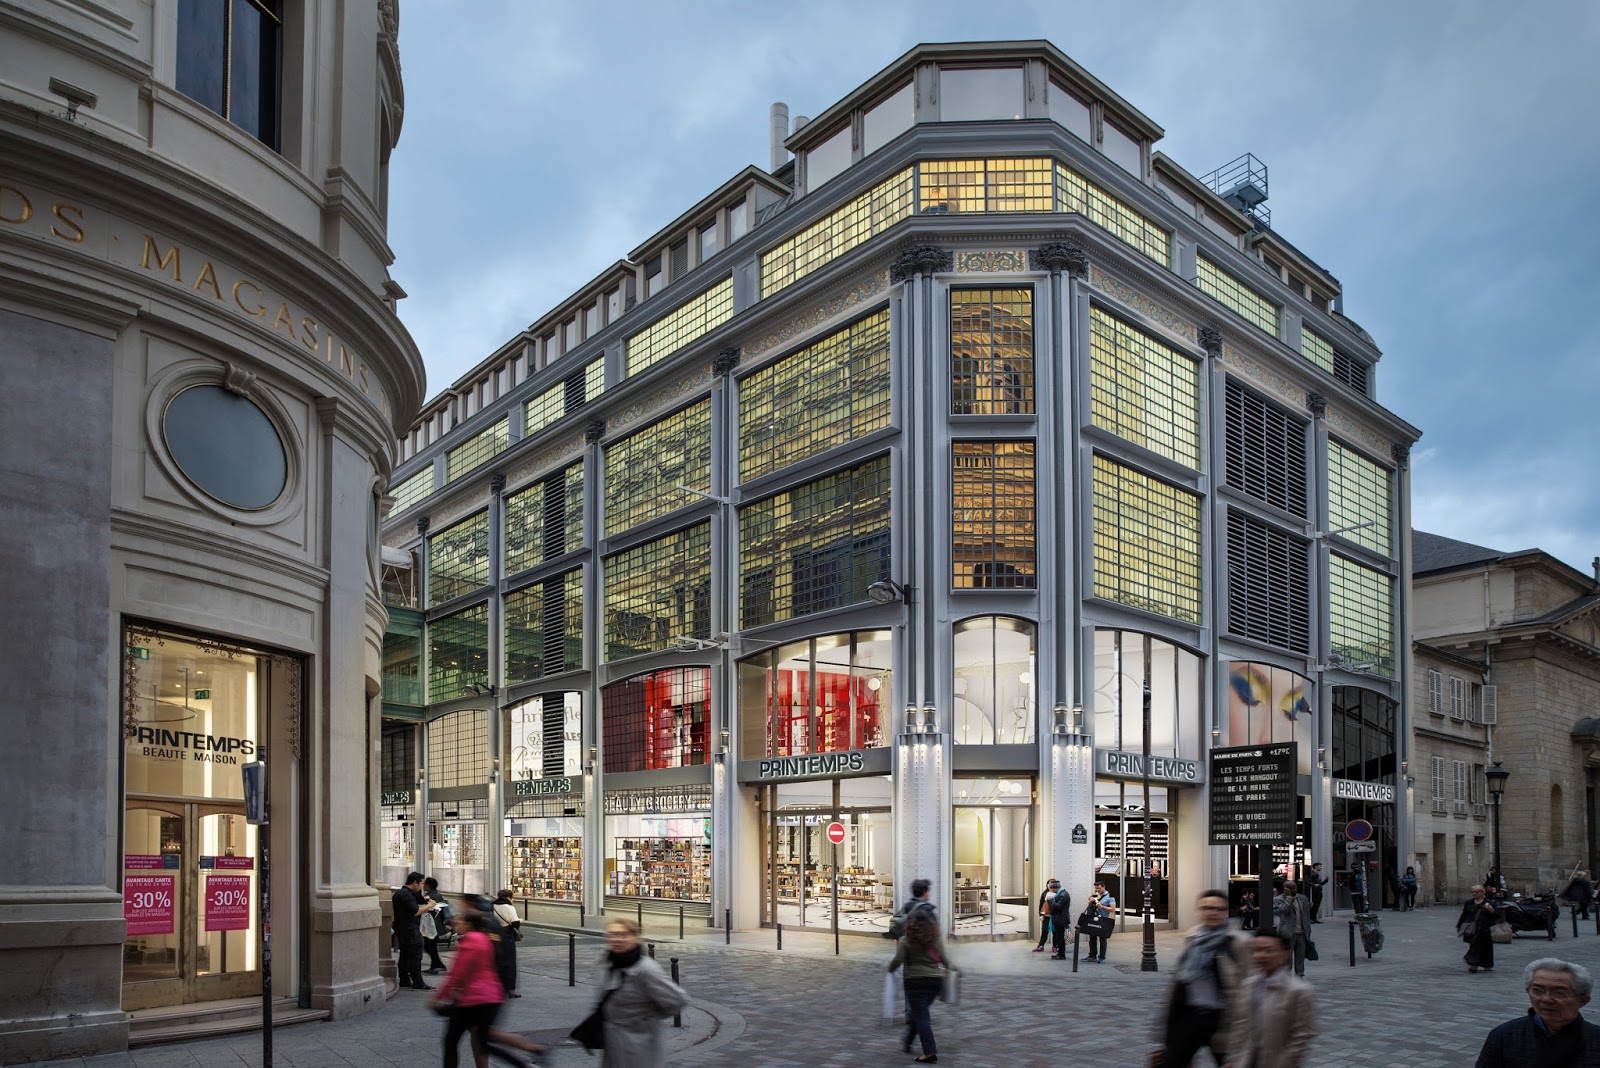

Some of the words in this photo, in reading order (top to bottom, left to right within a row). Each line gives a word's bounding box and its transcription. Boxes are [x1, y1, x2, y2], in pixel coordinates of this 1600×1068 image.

[139, 233, 369, 395] MAGASINS
[143, 746, 187, 760] BEAUTE
[194, 752, 237, 765] MAISON
[760, 752, 864, 779] PRINTEMPS
[1235, 765, 1255, 773] TEMPS
[1250, 773, 1278, 781] HANGOUT
[516, 778, 571, 796] PRINTEMPS
[1337, 781, 1392, 801] PRINTEMPS
[1216, 832, 1282, 840] PARIS.FR/HANGOUTS
[125, 891, 171, 908] -30%
[208, 889, 248, 906] -30%
